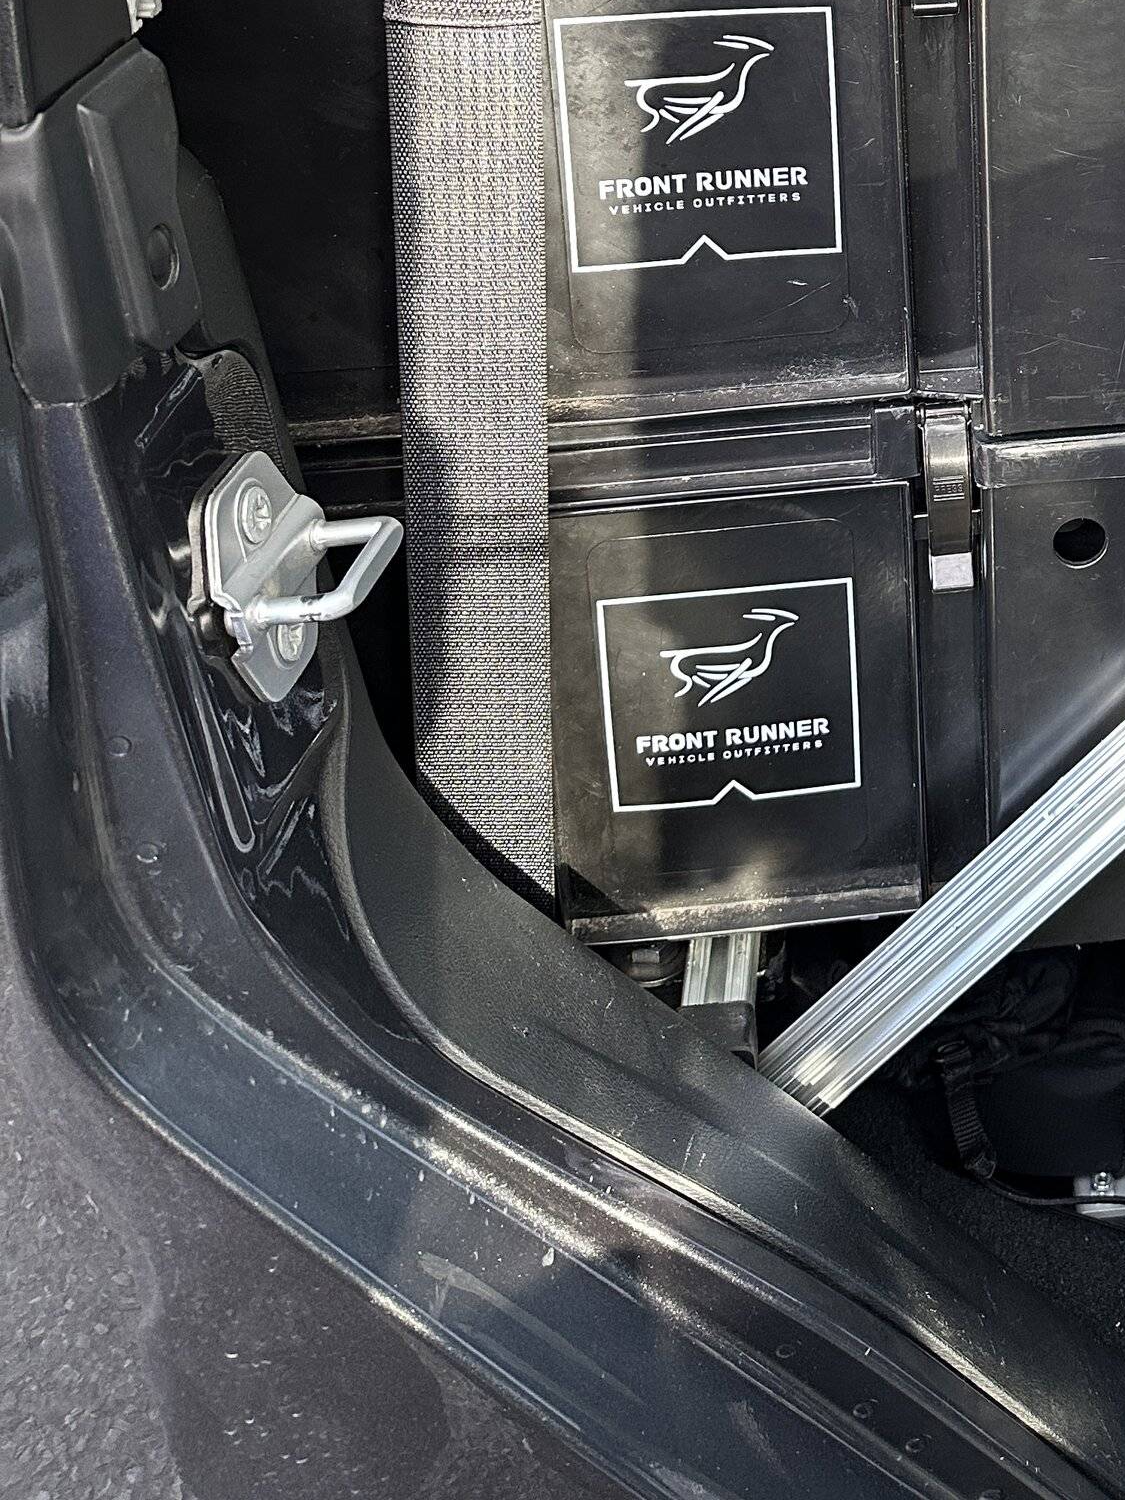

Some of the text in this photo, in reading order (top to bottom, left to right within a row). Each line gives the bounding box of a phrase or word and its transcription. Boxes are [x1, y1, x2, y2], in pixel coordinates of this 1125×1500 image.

[598, 166, 809, 201] FRONT RUNNER
[608, 192, 801, 216] VEHICLE OUTFITTERS
[635, 717, 831, 755] FRONT RUNNER
[645, 739, 824, 767] VEHICLE OUTFITTERS
